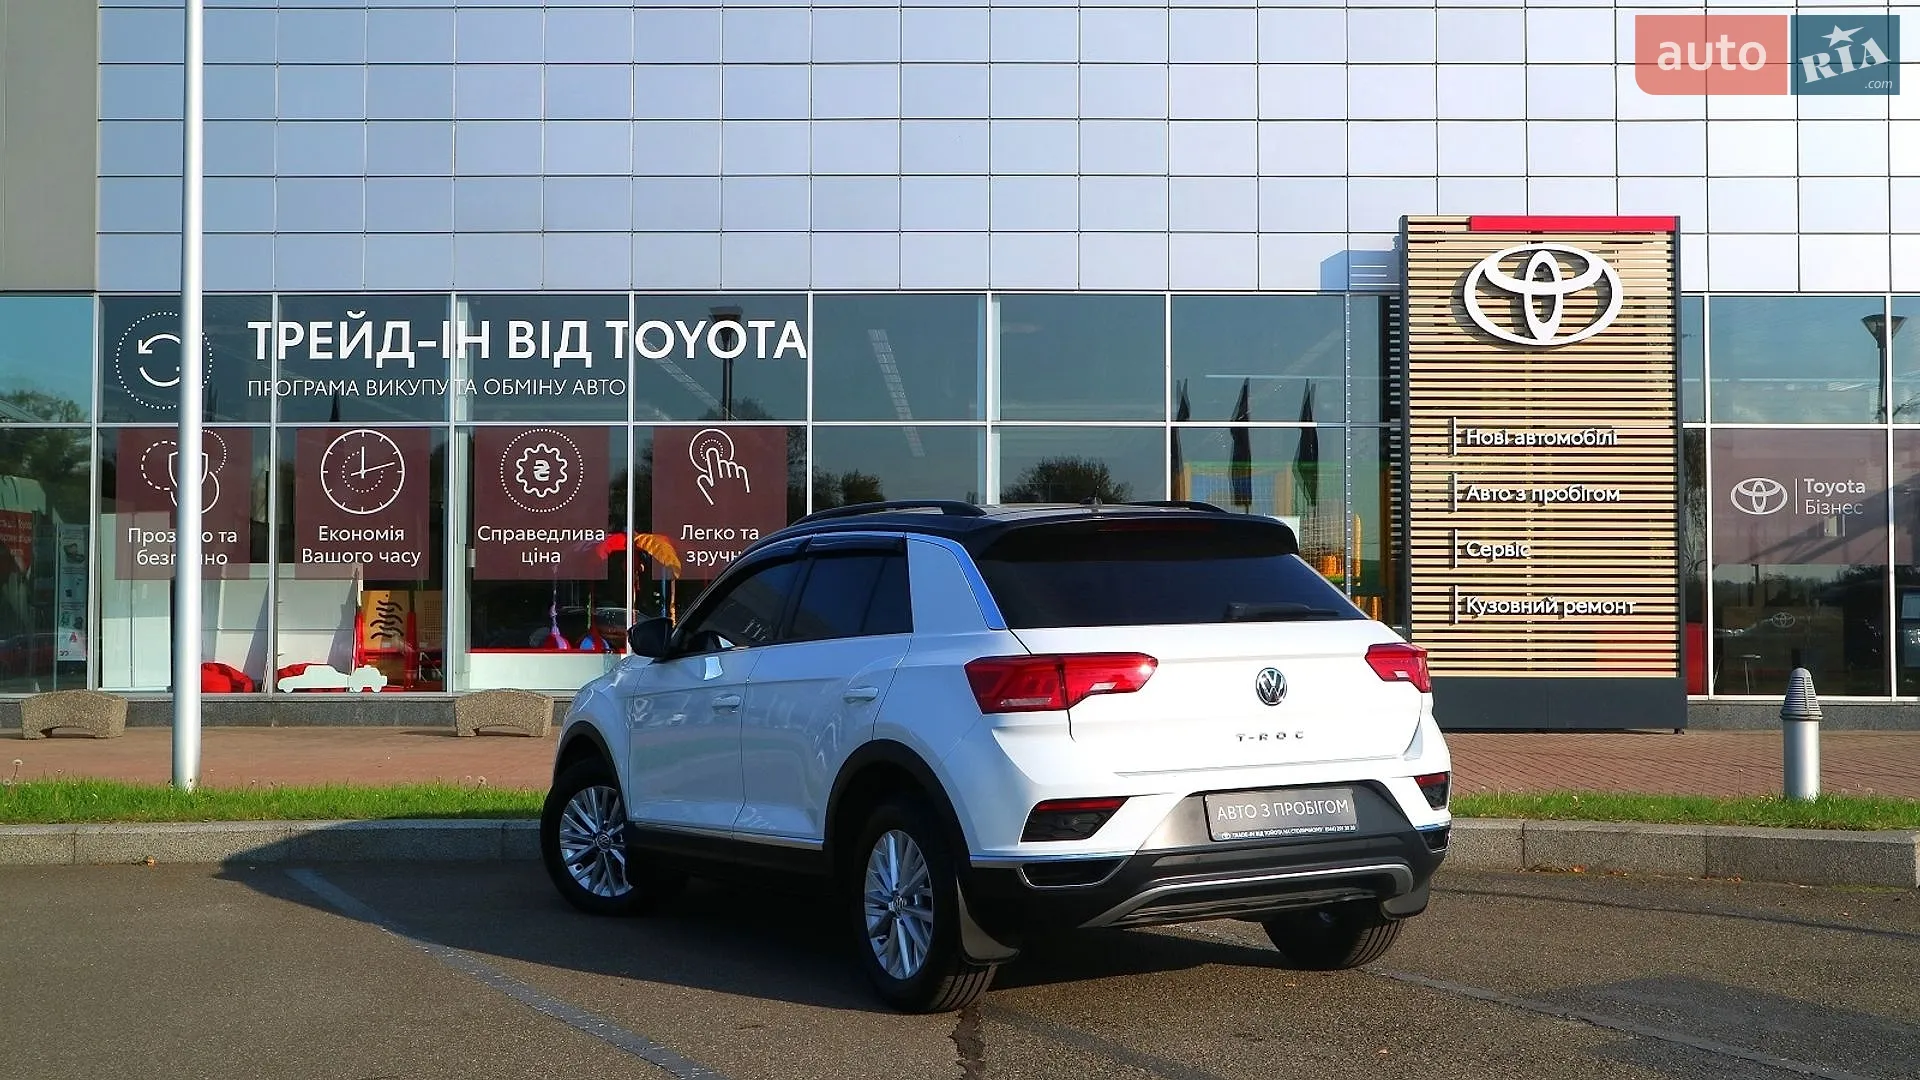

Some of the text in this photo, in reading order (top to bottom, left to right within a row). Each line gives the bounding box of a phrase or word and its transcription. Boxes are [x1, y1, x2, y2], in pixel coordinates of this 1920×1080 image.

[247, 310, 807, 368] ТРЕЙД-ІН ВІД TOYOTA
[248, 378, 627, 397] ПРОГРАМА ВИКУПУ ТА ОБМІНУ АВТО
[1466, 428, 1618, 446] Нові автомобілі
[1466, 486, 1510, 502] Авто
[1532, 484, 1620, 504] пробігом
[1803, 478, 1866, 497] Toyota
[1805, 500, 1864, 515] Бізнес
[128, 527, 238, 547] Прозо та
[318, 525, 405, 541] Економія
[477, 525, 606, 544] Справедлива
[680, 524, 759, 540] Легко та
[136, 549, 228, 566] безно
[302, 548, 422, 567] Вашого часу
[521, 548, 561, 566] ціна
[686, 550, 742, 567] зручн
[1466, 541, 1531, 560] Сервіс
[1466, 596, 1637, 616] Кузовний ремонт
[1236, 731, 1305, 742] T-ROC
[1217, 803, 1257, 821] АВТО
[1273, 799, 1349, 818] ПРОБІГОМ
